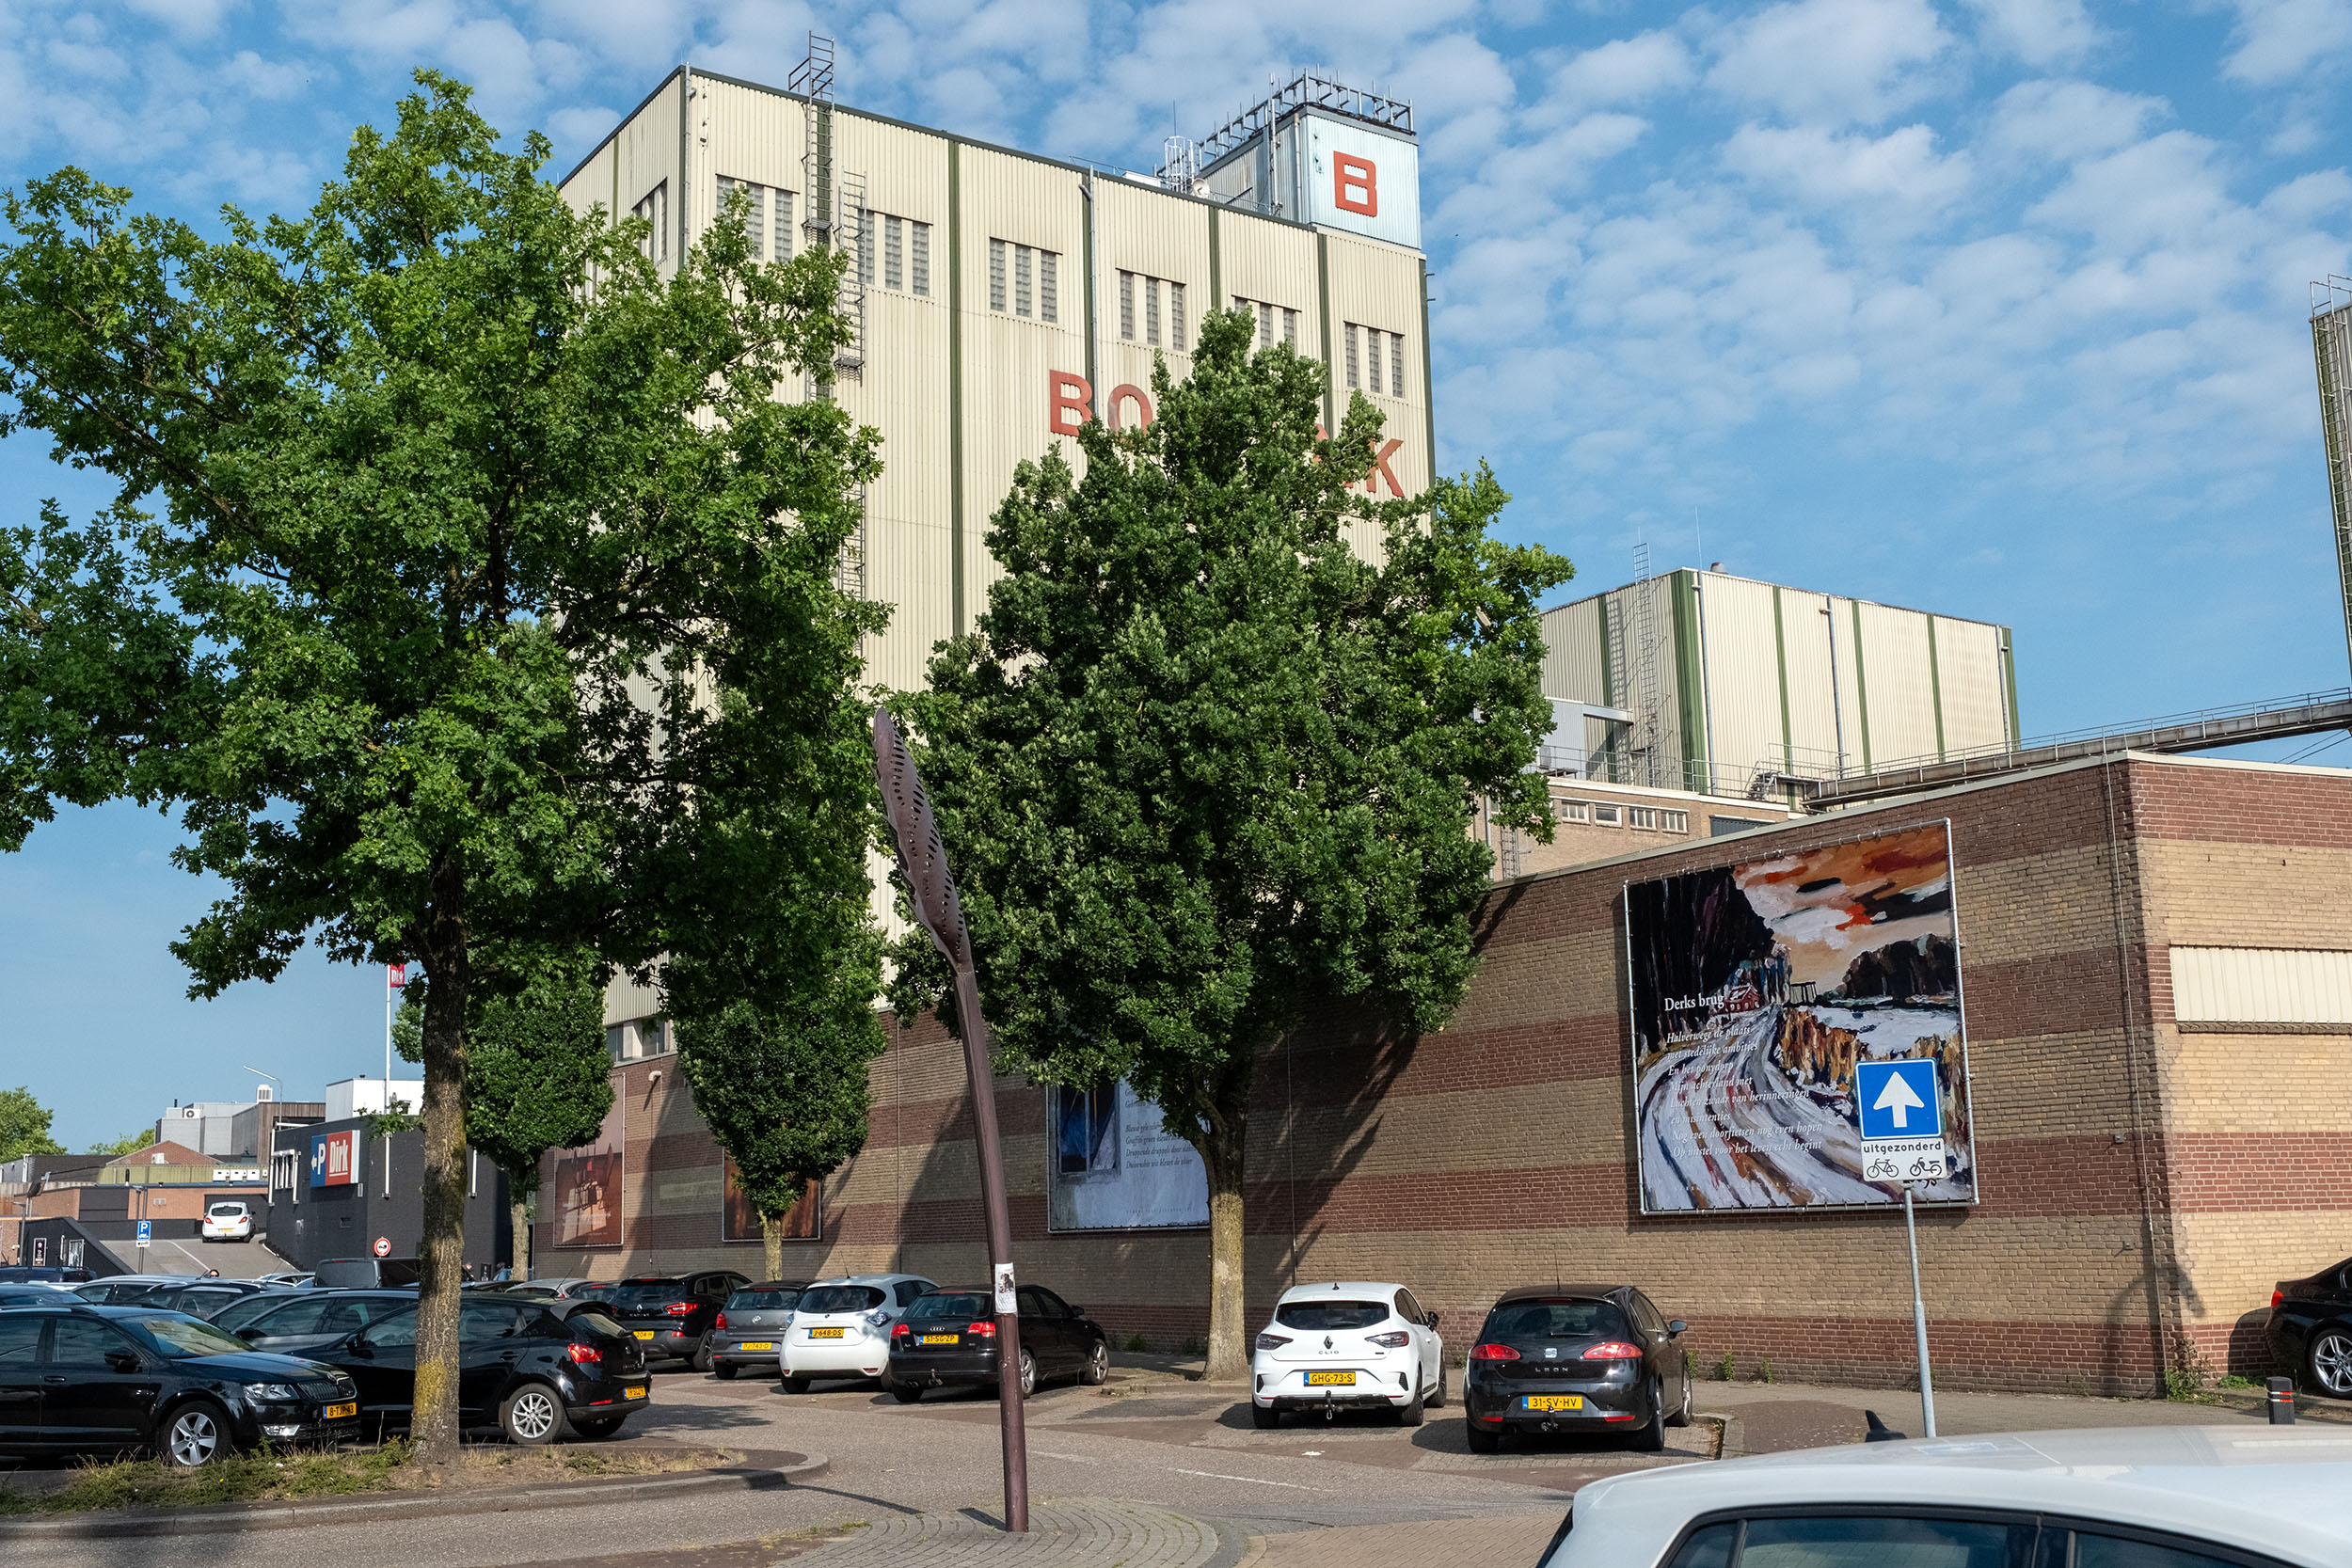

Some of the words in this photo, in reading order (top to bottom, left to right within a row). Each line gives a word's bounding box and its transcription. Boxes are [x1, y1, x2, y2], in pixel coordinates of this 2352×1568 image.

[1333, 150, 1378, 217] B
[1664, 994, 1696, 1011] Derks
[1698, 992, 1725, 1010] brug
[1666, 1030, 1712, 1043] Halverwege
[1714, 1027, 1724, 1037] de
[1725, 1025, 1751, 1039] plaats
[1667, 1051, 1682, 1060] met
[1683, 1043, 1722, 1059] stedelijke
[1723, 1040, 1757, 1053] ambities
[1668, 1065, 1679, 1076] En
[1681, 1063, 1694, 1074] het
[1694, 1060, 1734, 1078] ponydorp
[1669, 1082, 1690, 1094] Mijn
[1691, 1076, 1735, 1091] achterland
[1736, 1076, 1753, 1086] met
[1704, 1097, 1729, 1106] zwaar
[1731, 1094, 1747, 1103] van
[1749, 1089, 1810, 1102] herinneringen
[1671, 1116, 1681, 1125] en
[1682, 1111, 1731, 1124] misintenties
[1672, 1131, 1689, 1144] Nog
[1690, 1132, 1708, 1140] even
[1709, 1125, 1755, 1141] doorfietsen
[1756, 1127, 1772, 1138] nog
[1774, 1125, 1794, 1134] even
[1796, 1122, 1823, 1135] hopen
[317, 1143, 326, 1175] P
[329, 1139, 348, 1174] Dirk
[1673, 1147, 1686, 1160] Op
[1687, 1144, 1713, 1157] uitstel
[1714, 1145, 1733, 1155] voor
[1735, 1142, 1749, 1154] het
[1750, 1142, 1773, 1153] leven
[1774, 1139, 1792, 1151] echt
[1794, 1138, 1823, 1153] begint
[1863, 1141, 1942, 1155] uitgezonderd
[140, 1222, 149, 1233] P
[813, 1328, 842, 1337] J-648-DS
[1311, 1373, 1353, 1383] GHG-73-S
[1532, 1398, 1577, 1407] 31-SV-HV
